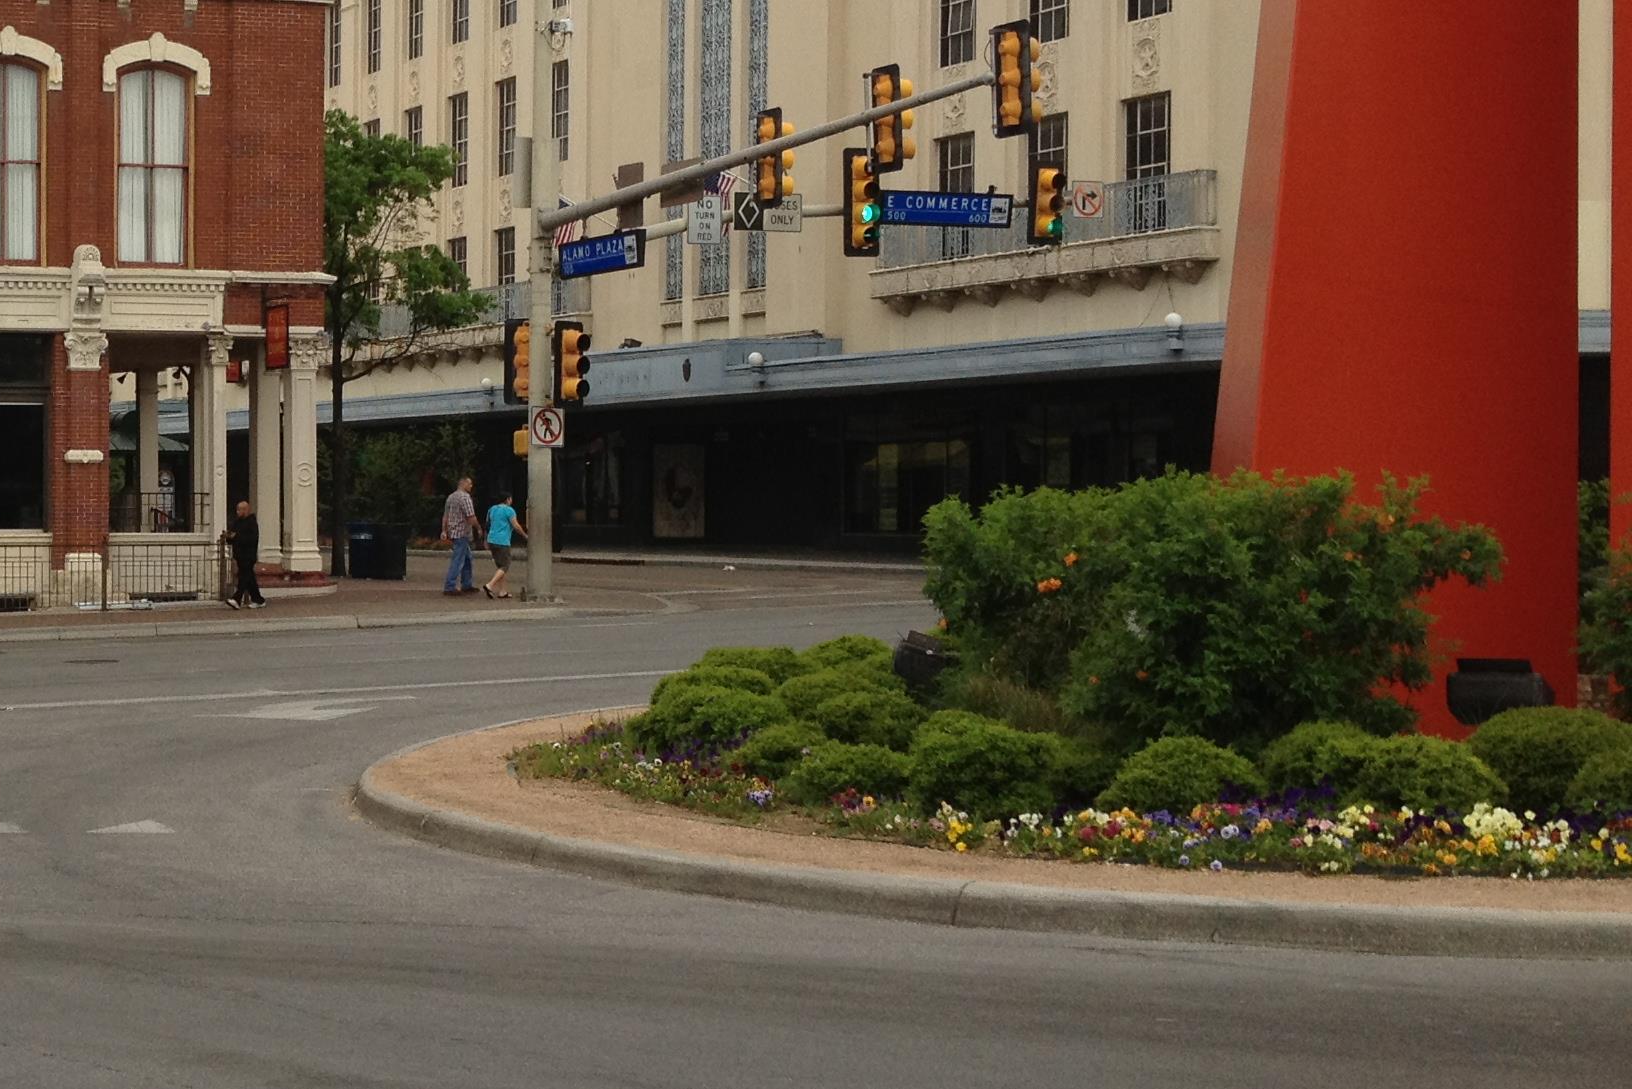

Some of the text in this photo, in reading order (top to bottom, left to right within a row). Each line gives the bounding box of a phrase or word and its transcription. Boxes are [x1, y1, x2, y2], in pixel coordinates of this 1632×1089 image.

[697, 200, 713, 209] NO
[887, 195, 989, 211] E COMMERCE
[770, 215, 794, 225] ONLY
[887, 211, 906, 220] 500
[968, 214, 987, 223] 600
[699, 222, 710, 230] ON
[697, 233, 712, 241] RED
[562, 239, 624, 262] ALAMO PLAZA
